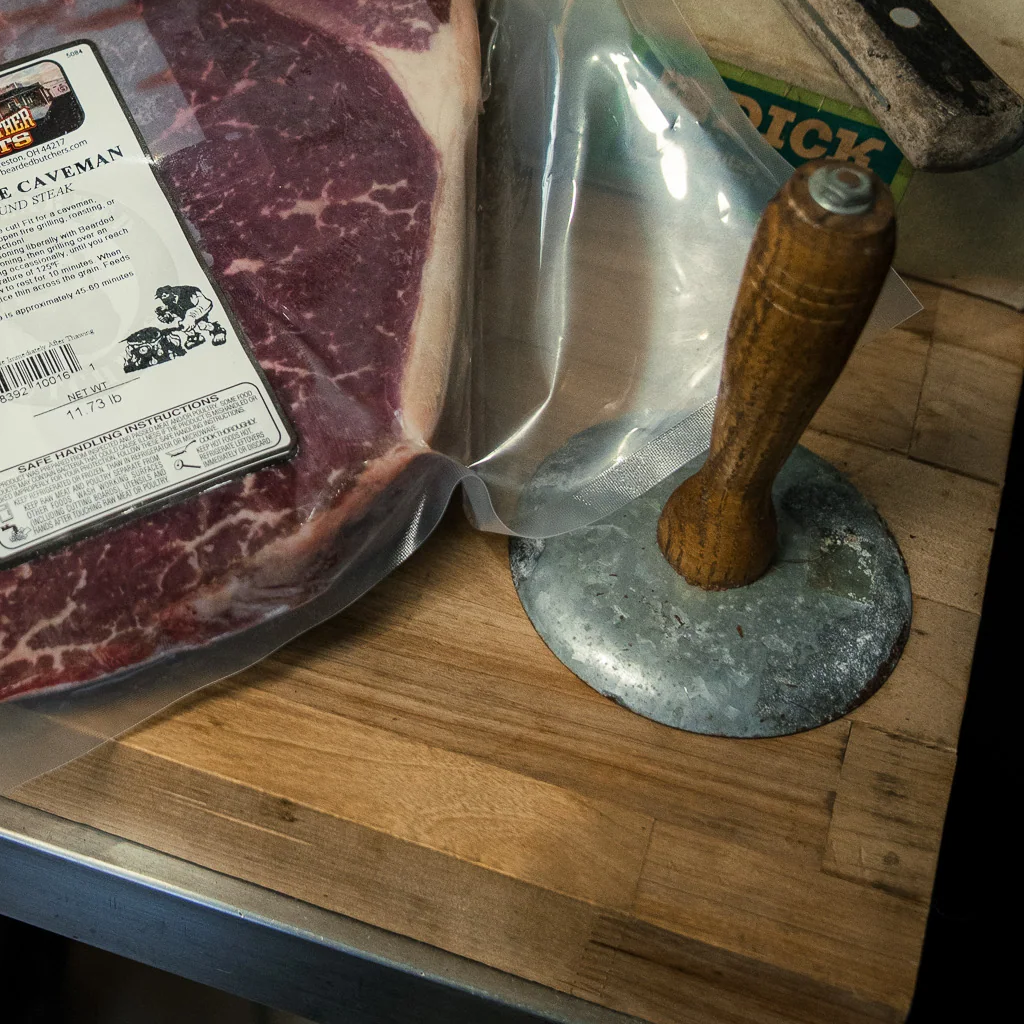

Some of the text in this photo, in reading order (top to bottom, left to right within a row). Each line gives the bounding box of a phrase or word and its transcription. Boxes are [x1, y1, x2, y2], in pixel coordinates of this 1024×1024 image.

[25, 147, 41, 158] OH
[37, 137, 65, 152] 44217
[16, 144, 123, 193] CAVEMAN
[31, 182, 74, 205] STEAK
[19, 226, 35, 235] fire
[36, 216, 68, 231] grilling,
[67, 202, 106, 219] roasting,
[105, 198, 115, 206] or
[21, 217, 34, 227] Fit
[34, 213, 47, 222] for
[56, 198, 97, 215] caveman,
[24, 235, 58, 253] liberally
[59, 229, 77, 240] with
[77, 214, 115, 233] Bearded
[25, 249, 45, 259] then
[46, 238, 75, 254] grilling
[76, 231, 94, 243] over
[96, 227, 108, 235] an
[68, 242, 87, 254] until
[87, 237, 104, 249] you
[104, 227, 129, 241] reach
[4, 284, 15, 292] to
[15, 277, 33, 288] rest
[33, 274, 46, 283] for
[48, 269, 60, 278] 10
[96, 248, 122, 261] When
[14, 287, 31, 297] thin
[32, 278, 61, 292] across
[61, 273, 76, 282] the
[102, 253, 131, 268] Feeds
[24, 268, 34, 277] of
[4, 311, 14, 319] is
[14, 292, 73, 315] approximately
[101, 271, 134, 287] minutes
[33, 369, 72, 391] 10016
[87, 361, 97, 371] 1
[65, 379, 110, 403] NET WT
[66, 393, 122, 420] 11.73 lb
[17, 391, 219, 473] SAFE HANDLING INSTRUCTIONS
